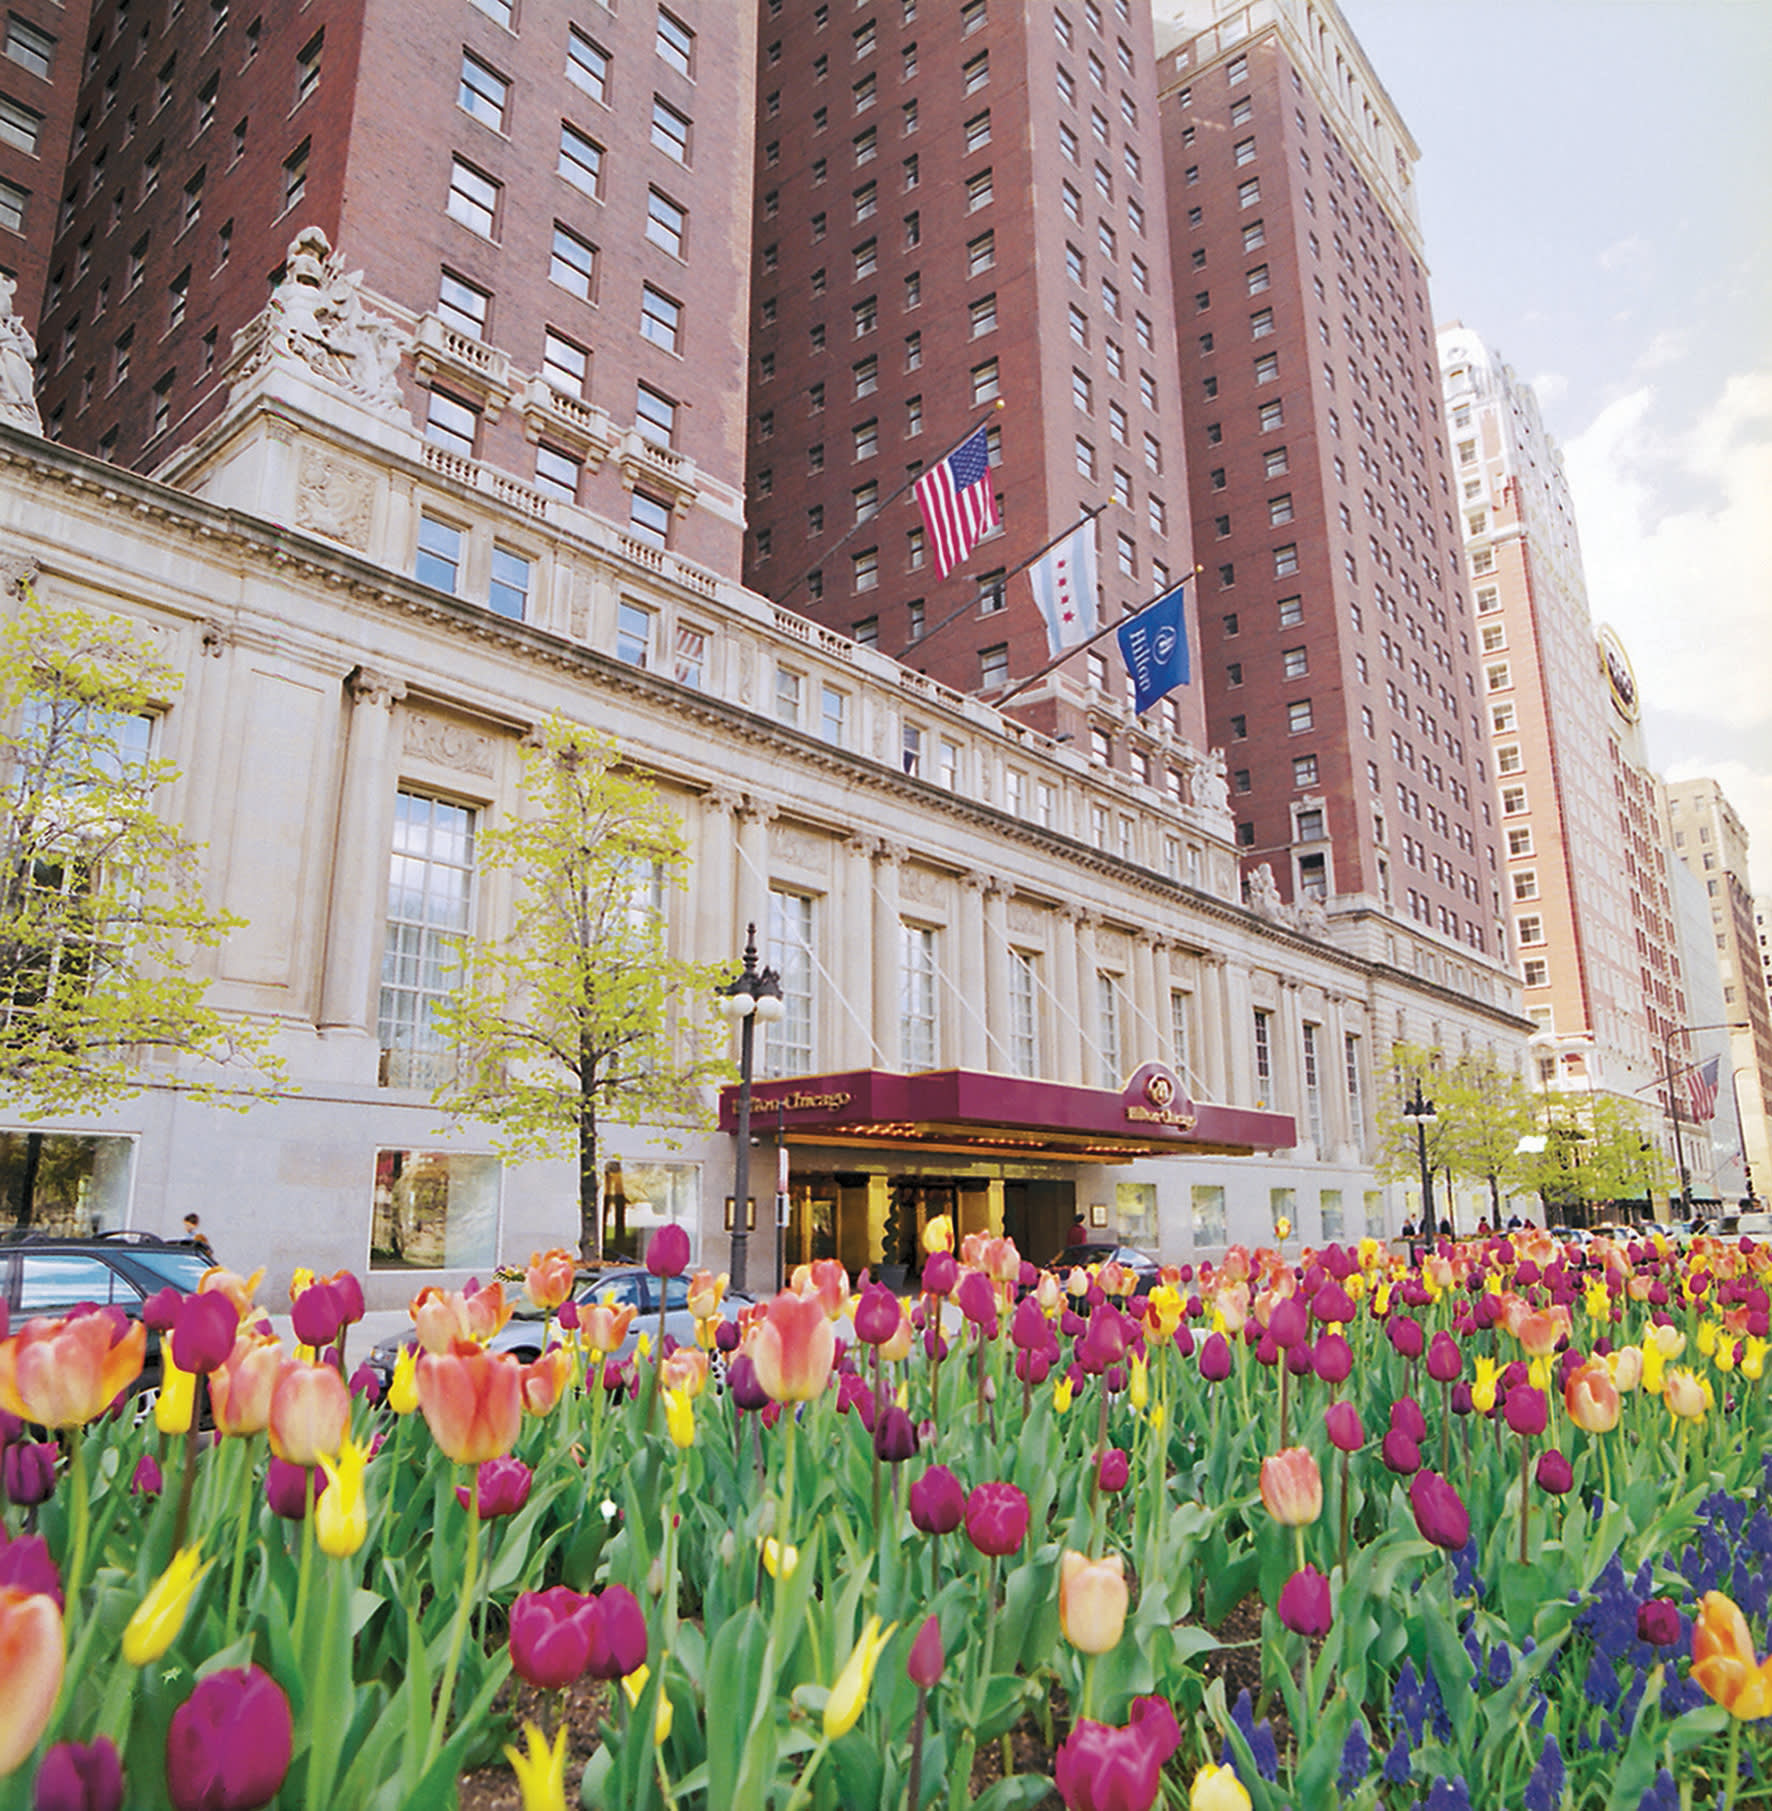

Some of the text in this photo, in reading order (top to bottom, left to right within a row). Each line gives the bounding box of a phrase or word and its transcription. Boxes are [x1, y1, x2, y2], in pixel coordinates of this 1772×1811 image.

[1129, 627, 1151, 692] Hilton
[732, 1090, 851, 1114] lton Chicago
[1127, 1105, 1198, 1134] Hilton Chicago
